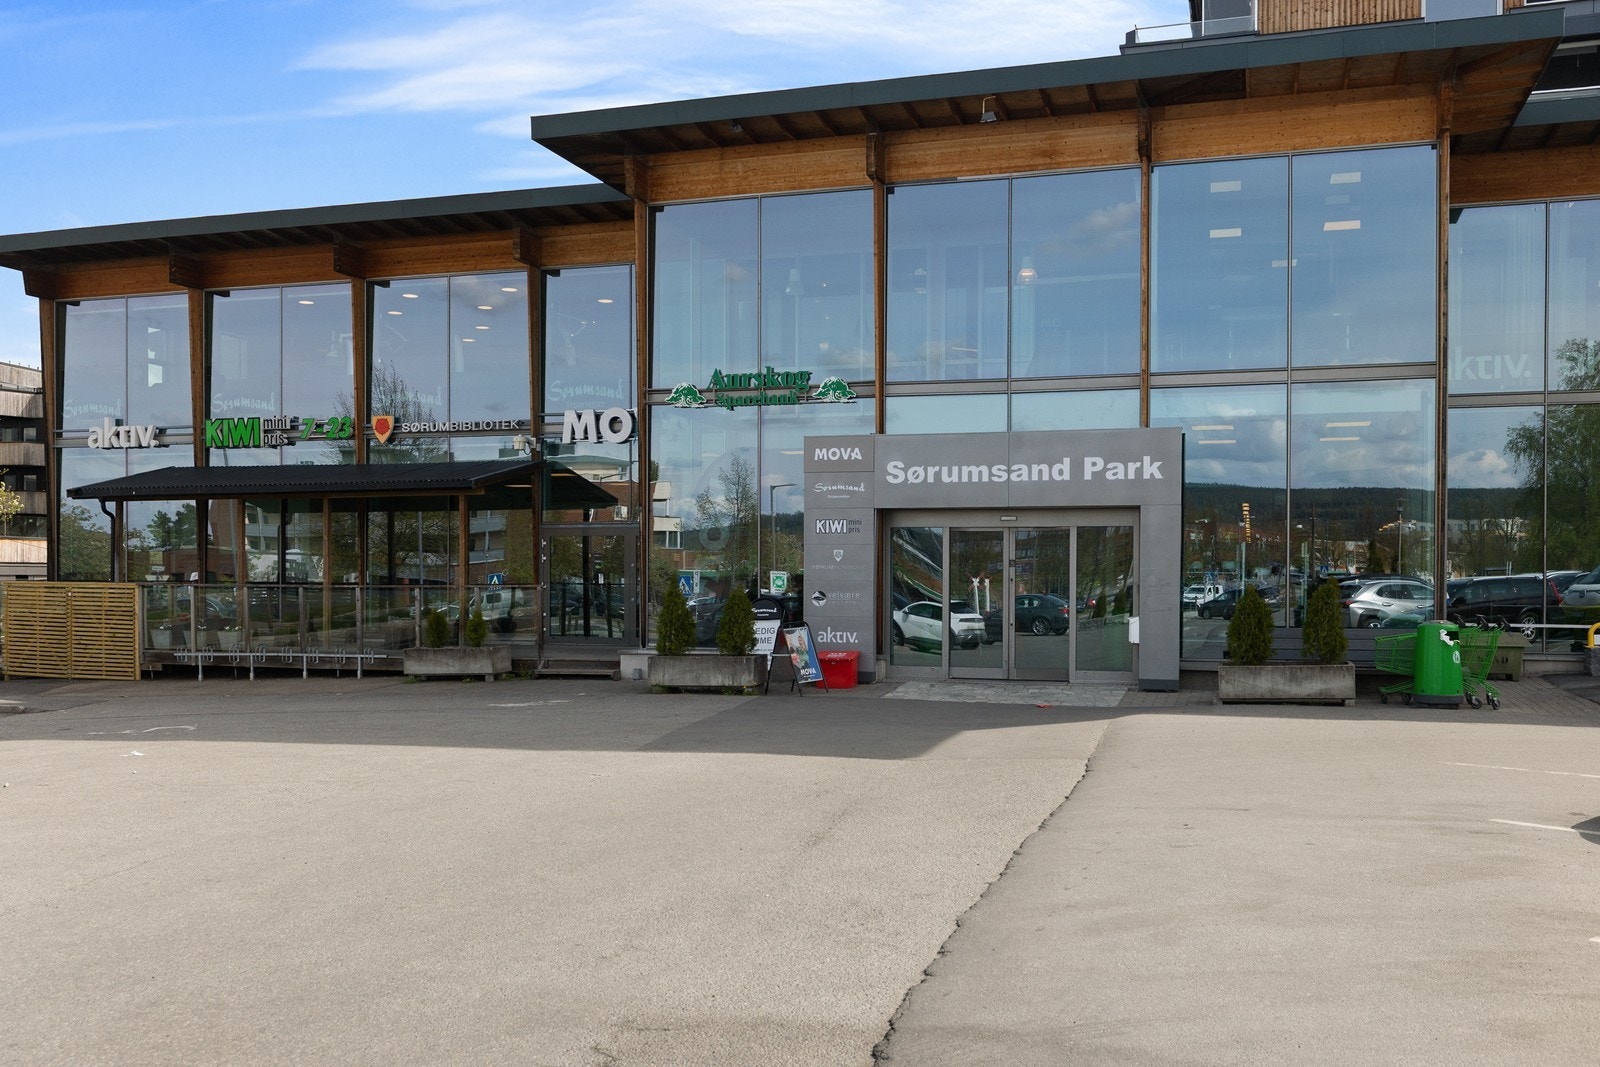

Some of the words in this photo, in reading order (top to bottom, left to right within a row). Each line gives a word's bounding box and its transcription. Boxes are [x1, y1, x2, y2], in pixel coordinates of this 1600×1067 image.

[707, 366, 812, 393] Aurskog
[717, 391, 799, 411] Sparebank
[204, 417, 261, 449] KIWI
[263, 415, 288, 429] mini
[401, 419, 520, 433] SØRUMBIBLIOTEK
[562, 407, 638, 444] MO
[263, 431, 286, 448] pris
[814, 447, 863, 461] MOVA
[886, 457, 1071, 484] Sørumsand
[1083, 455, 1164, 480] Park
[815, 518, 848, 534] KIWI
[848, 518, 862, 526] mini
[848, 526, 861, 534] pris
[755, 627, 776, 635] EDIG
[757, 636, 773, 645] IME
[800, 667, 817, 676] MOVA
